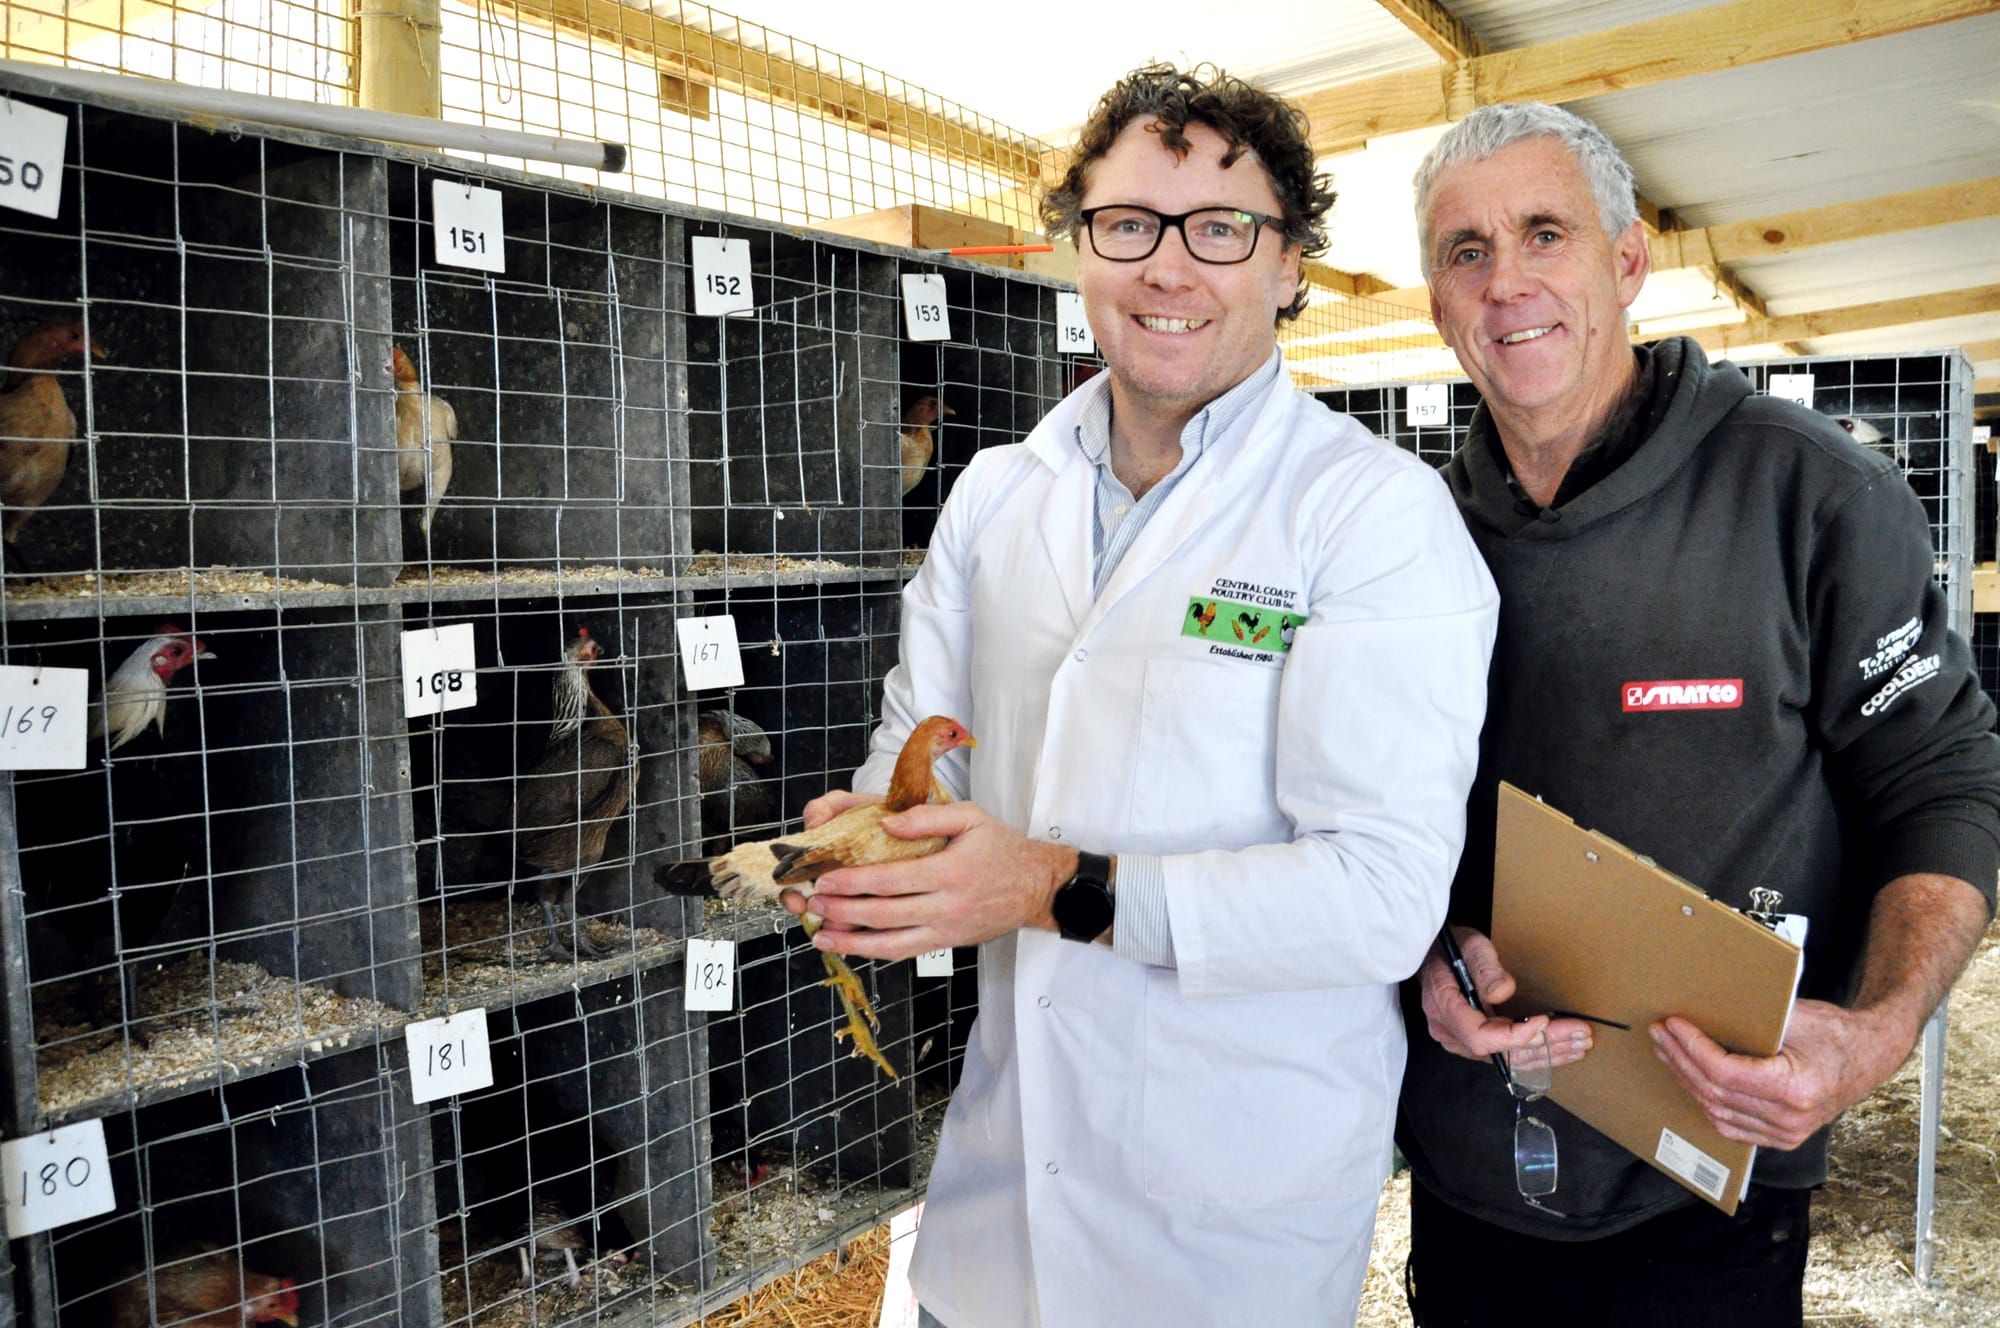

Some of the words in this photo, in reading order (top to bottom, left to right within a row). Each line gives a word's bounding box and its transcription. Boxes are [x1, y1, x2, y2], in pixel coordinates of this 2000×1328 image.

[450, 226, 485, 254] 151
[706, 273, 741, 295] 152
[915, 304, 940, 322] 153
[1065, 326, 1085, 342] 154
[1415, 404, 1437, 416] 157
[1210, 587, 1256, 602] POULTRY
[1255, 594, 1283, 608] CLUB
[1215, 578, 1263, 595] CENTRAL
[1263, 586, 1298, 600] COAST
[693, 643, 719, 665] 167
[1209, 645, 1254, 661] Established
[1642, 684, 1738, 705] STRATCO
[1, 705, 58, 738] 169
[694, 962, 727, 991] 182
[428, 1039, 466, 1076] 181
[22, 1156, 91, 1208] 180
